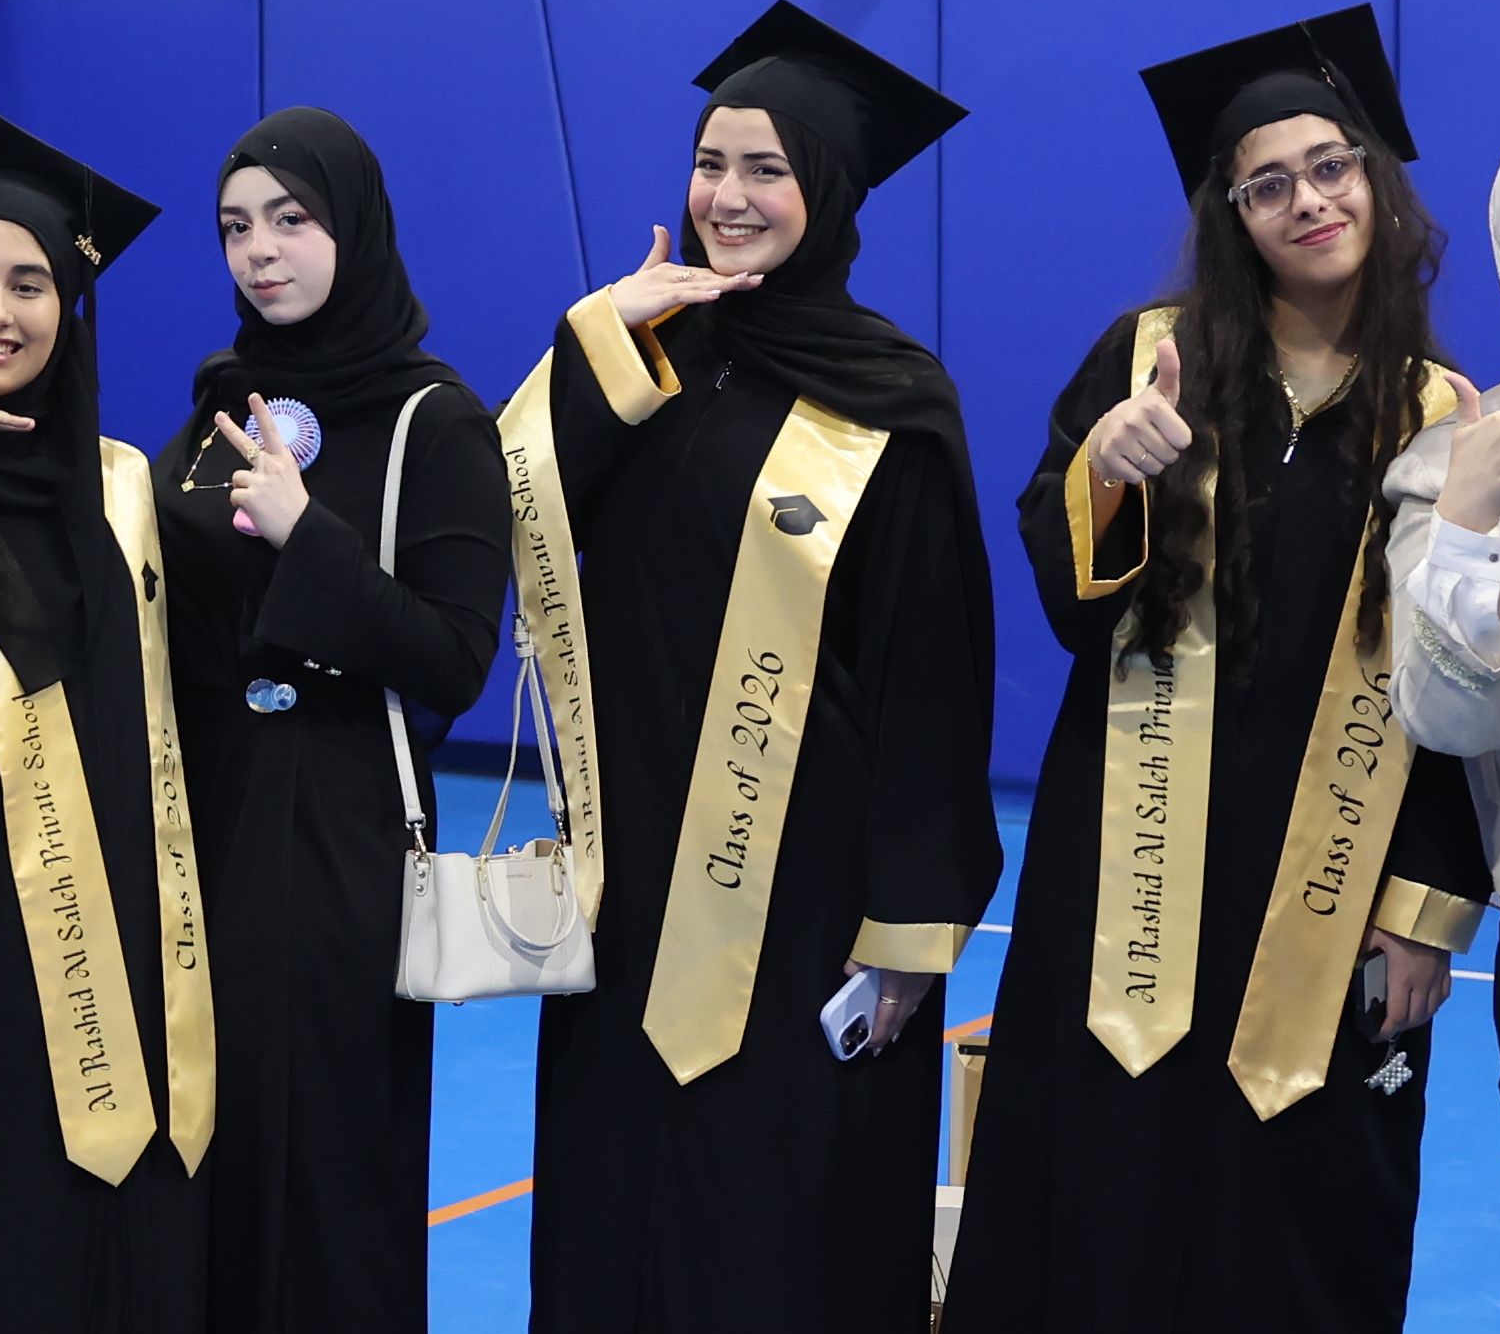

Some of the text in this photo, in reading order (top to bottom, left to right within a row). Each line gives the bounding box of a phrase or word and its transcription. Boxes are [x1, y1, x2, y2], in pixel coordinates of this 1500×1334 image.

[505, 445, 538, 523] School
[529, 530, 567, 621] Private
[552, 621, 579, 686] Saleh
[567, 693, 582, 725] Al
[706, 647, 784, 890] Class of 2026
[1135, 754, 1170, 825] Saleh
[1302, 667, 1394, 917] Class of 2026
[167, 843, 186, 879] of
[1133, 832, 1166, 866] Al
[11, 695, 118, 1114] Al Rashid Al Saleh Private School
[176, 889, 197, 971] Class
[1127, 871, 1164, 965] Rashid
[1125, 970, 1158, 1006] Al
